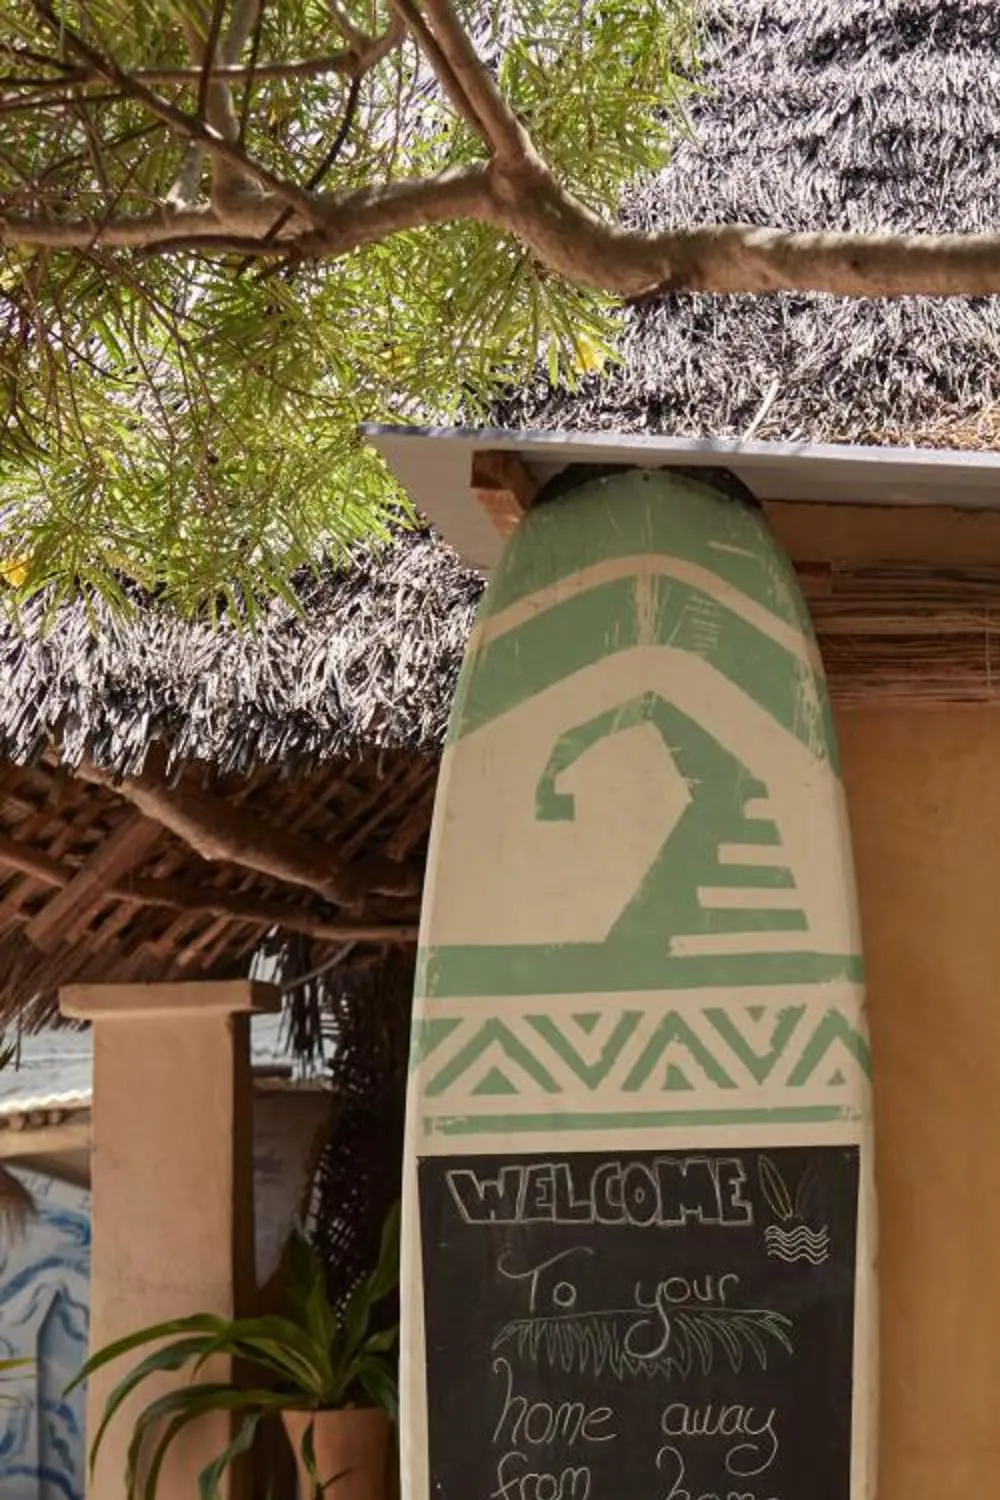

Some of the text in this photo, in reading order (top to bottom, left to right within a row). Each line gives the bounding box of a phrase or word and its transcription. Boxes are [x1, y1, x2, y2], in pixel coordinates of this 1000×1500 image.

[446, 1156, 753, 1228] WELCOME
[498, 1246, 740, 1358] To your
[492, 1357, 778, 1476] home away
